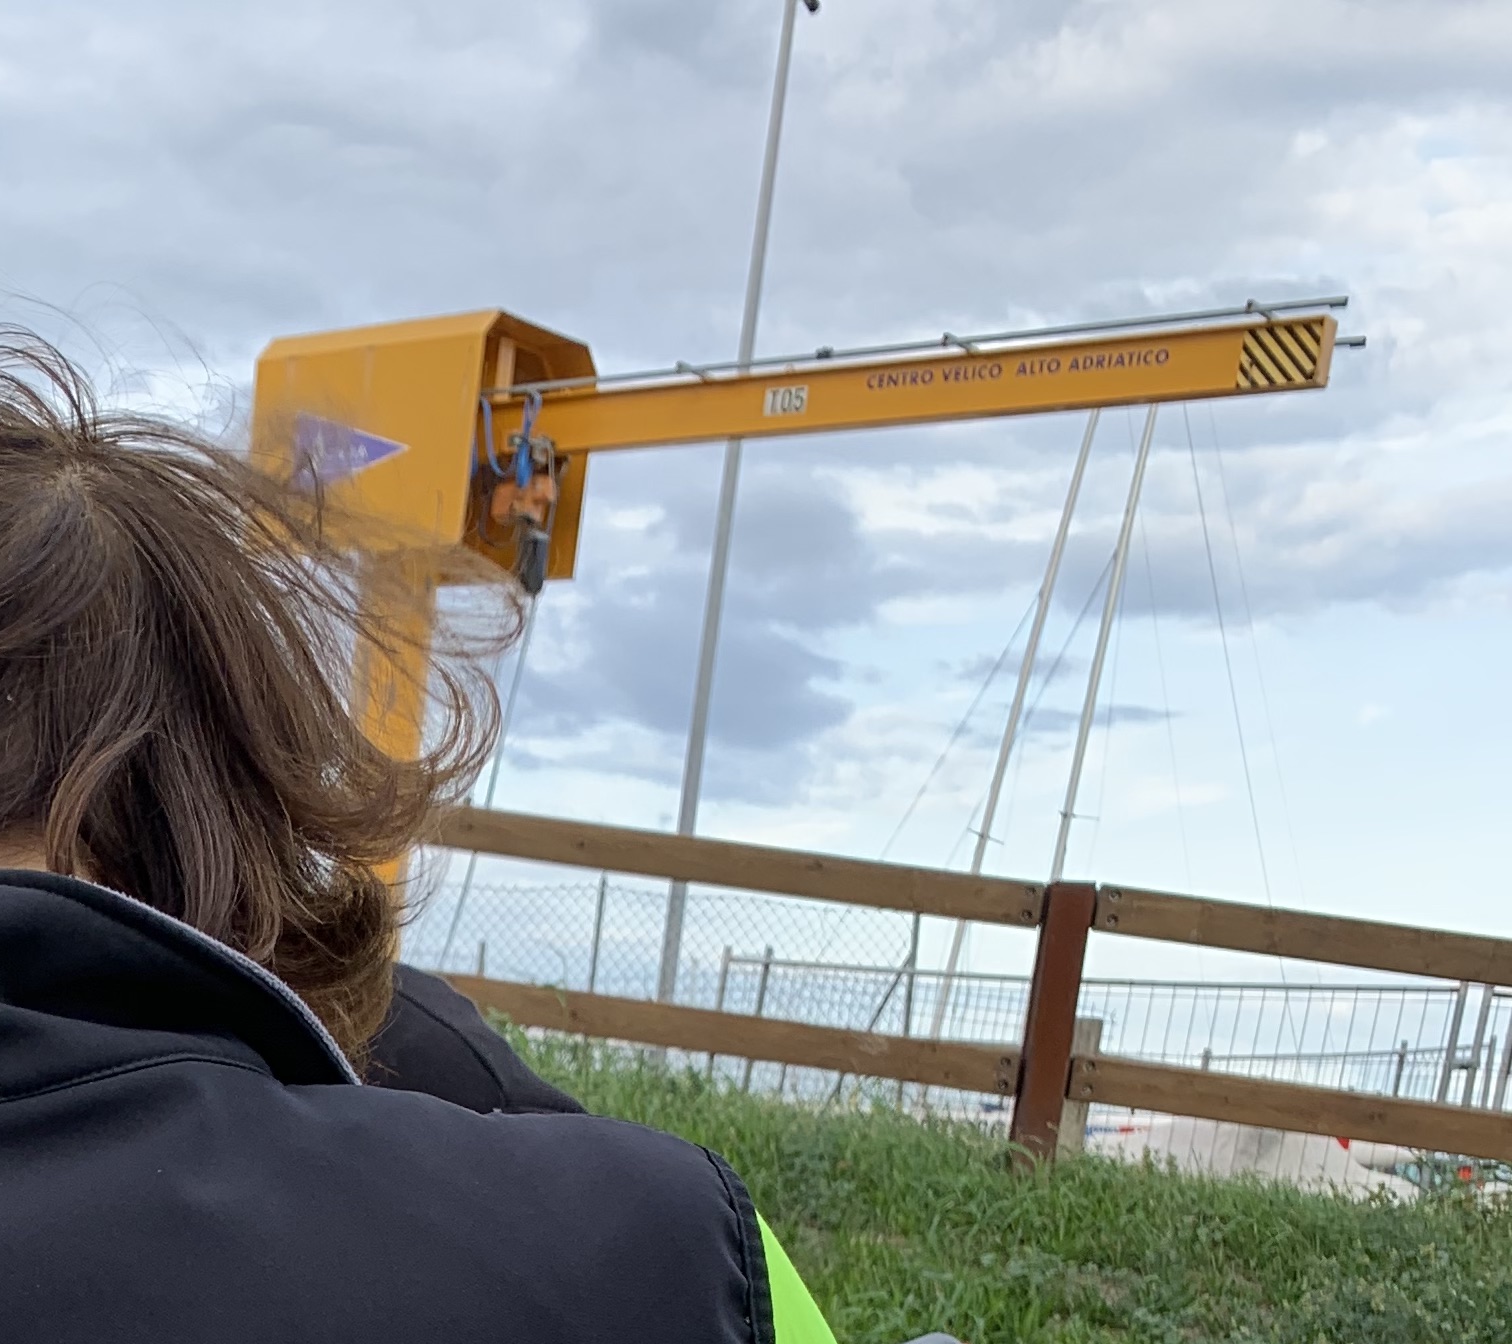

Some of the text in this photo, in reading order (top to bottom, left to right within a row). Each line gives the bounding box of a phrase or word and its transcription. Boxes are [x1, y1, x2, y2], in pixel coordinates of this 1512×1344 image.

[866, 348, 1170, 390] CENTRO VELICO ALTO ADRIATICO
